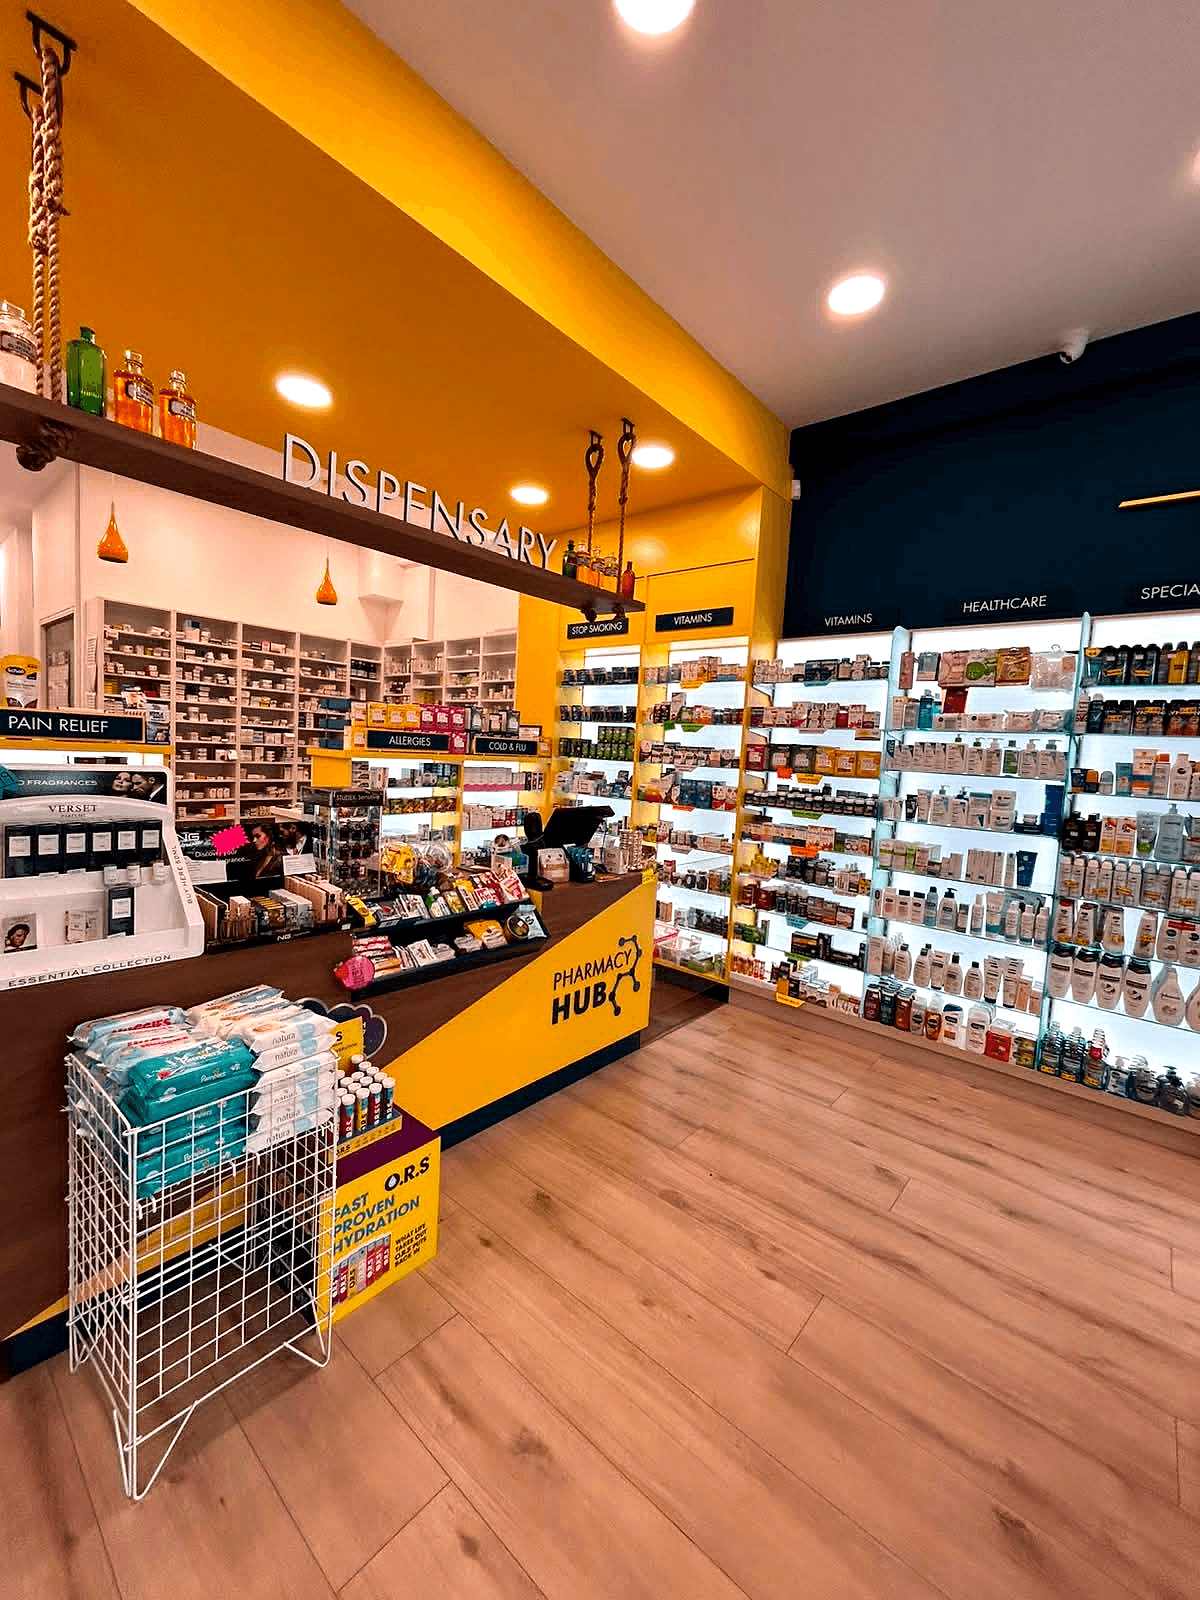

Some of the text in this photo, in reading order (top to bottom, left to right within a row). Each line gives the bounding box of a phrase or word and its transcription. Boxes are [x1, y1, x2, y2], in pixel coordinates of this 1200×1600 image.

[282, 433, 558, 570] DISPENSARY
[962, 596, 1048, 613] HEALTHCARE
[673, 612, 713, 626] VITAMINS
[824, 613, 873, 627] VITAMINS
[572, 622, 623, 635] STOP SMOKING
[8, 716, 109, 734] PAIN RELIEF
[389, 736, 432, 747] ALLERGIES
[488, 742, 508, 750] COLD
[516, 743, 527, 752] FLU
[48, 804, 97, 814] VERSET
[8, 954, 172, 988] ESSENTIAL COLLECTION
[554, 949, 632, 990] PHARMACY
[552, 982, 606, 1025] HUB
[272, 1032, 296, 1045] natura
[384, 1156, 430, 1192] O.R.S
[334, 1195, 394, 1238] PROVEN
[333, 1196, 420, 1256] HYDRATION
